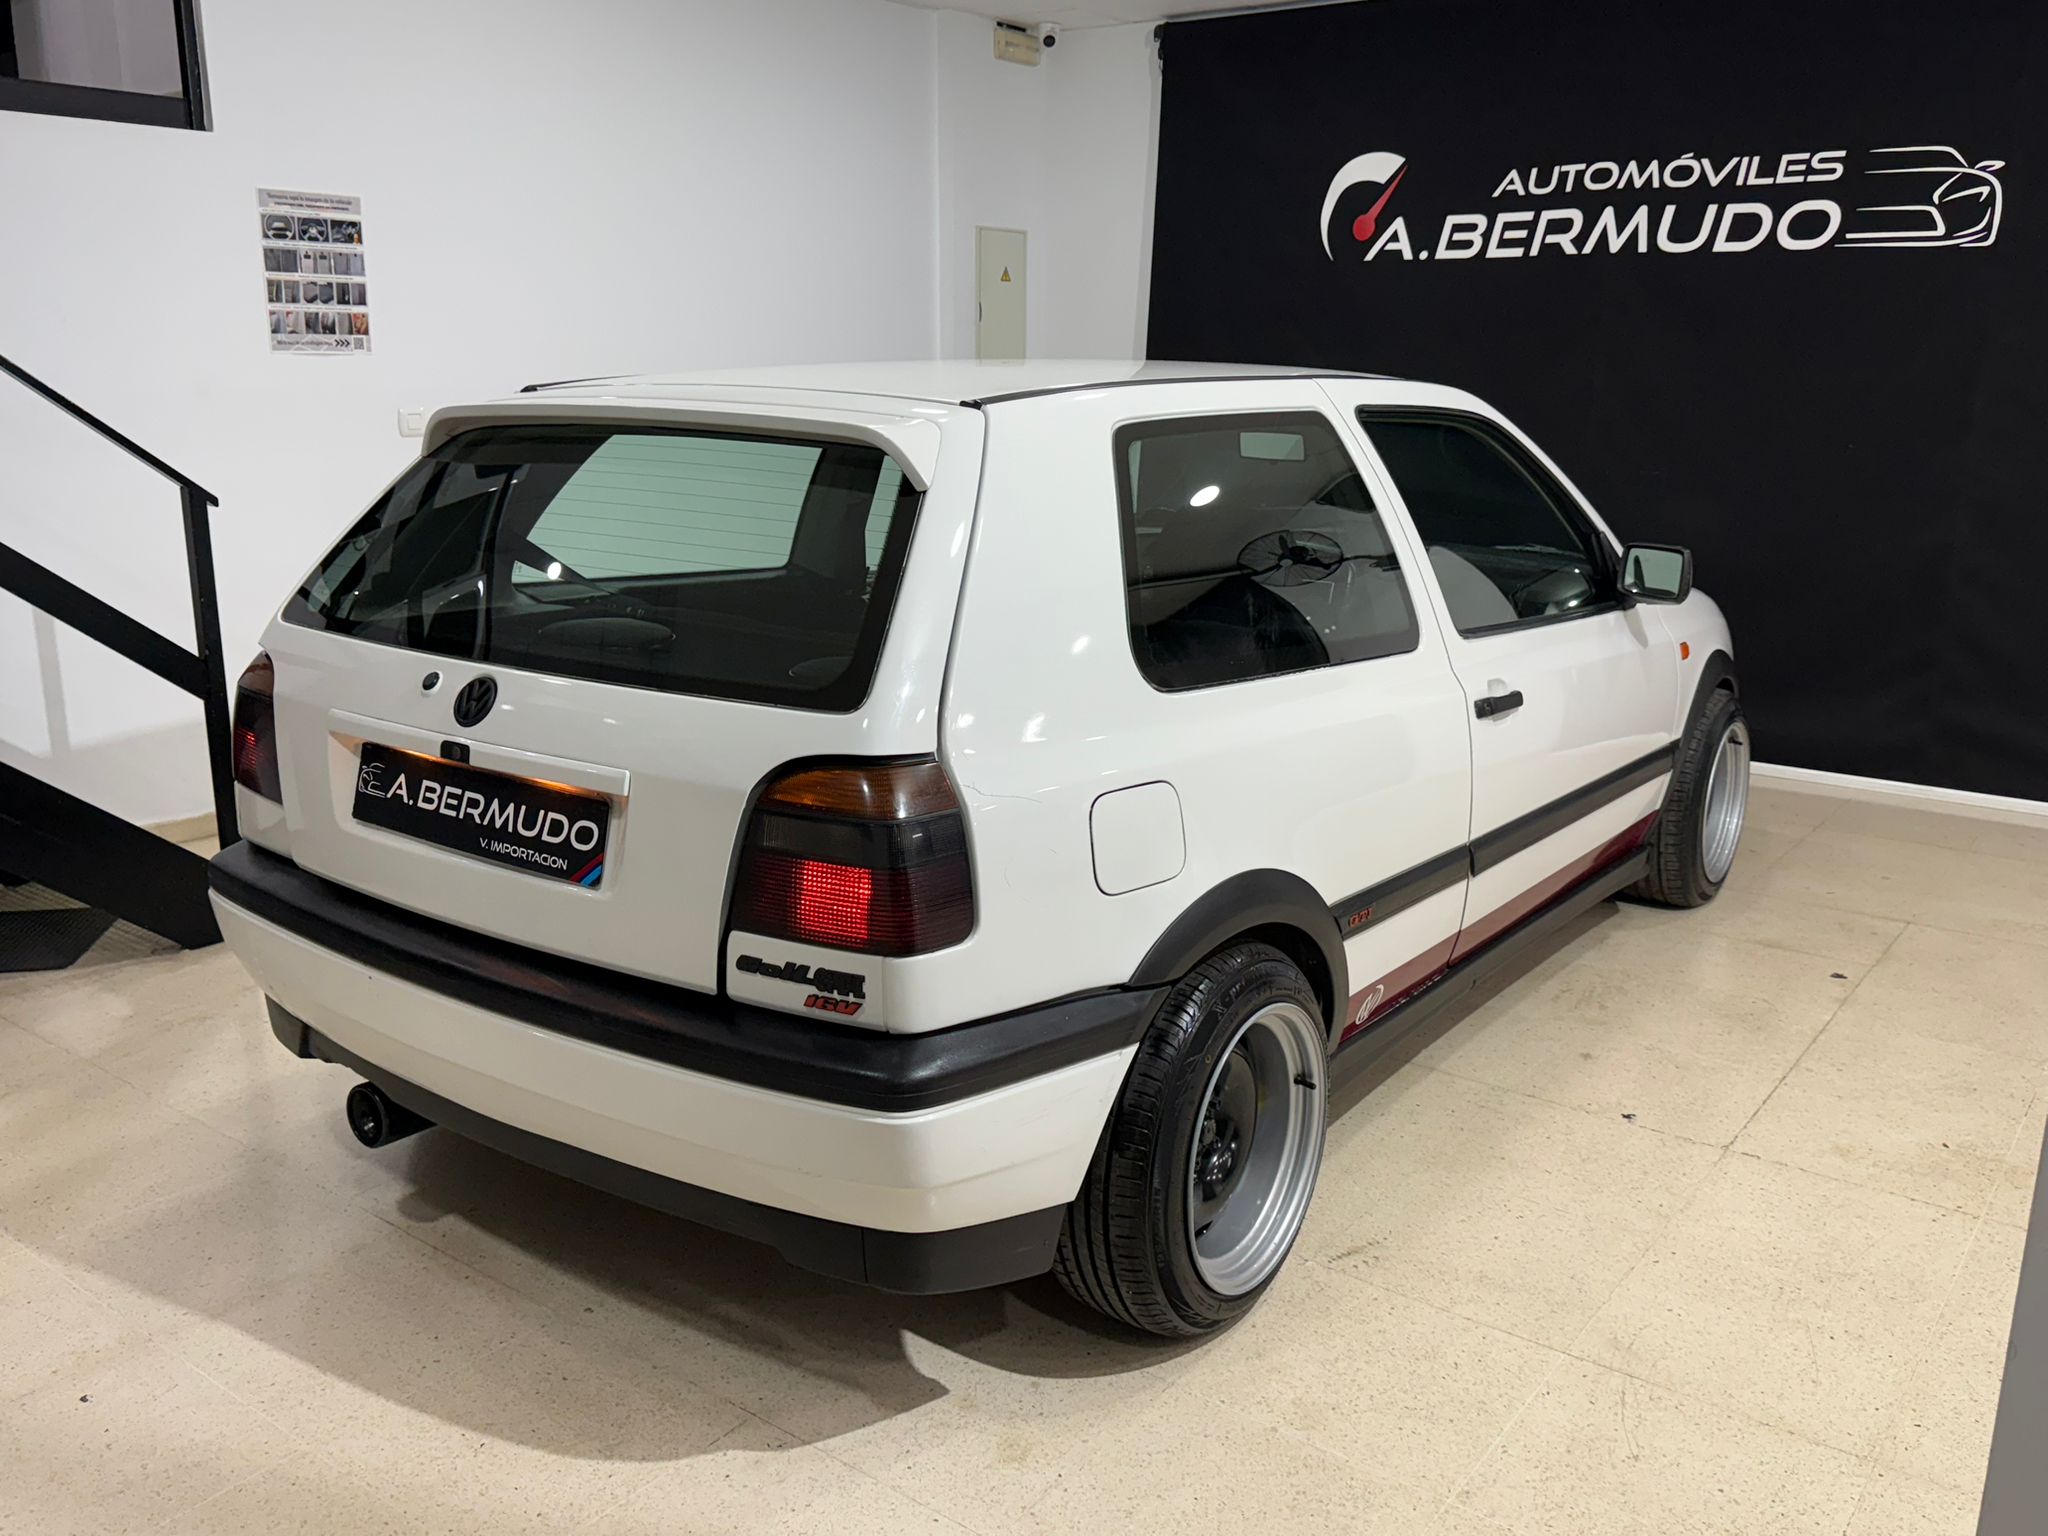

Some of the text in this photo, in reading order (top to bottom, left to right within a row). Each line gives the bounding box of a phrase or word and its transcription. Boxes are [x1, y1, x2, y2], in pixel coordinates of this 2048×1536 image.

[1491, 150, 1847, 198] AUTOMÓVILES
[1363, 199, 1842, 262] A.BERMUDO
[386, 772, 599, 851] A.BERMUDO
[479, 837, 569, 871] V. IMPORTACION
